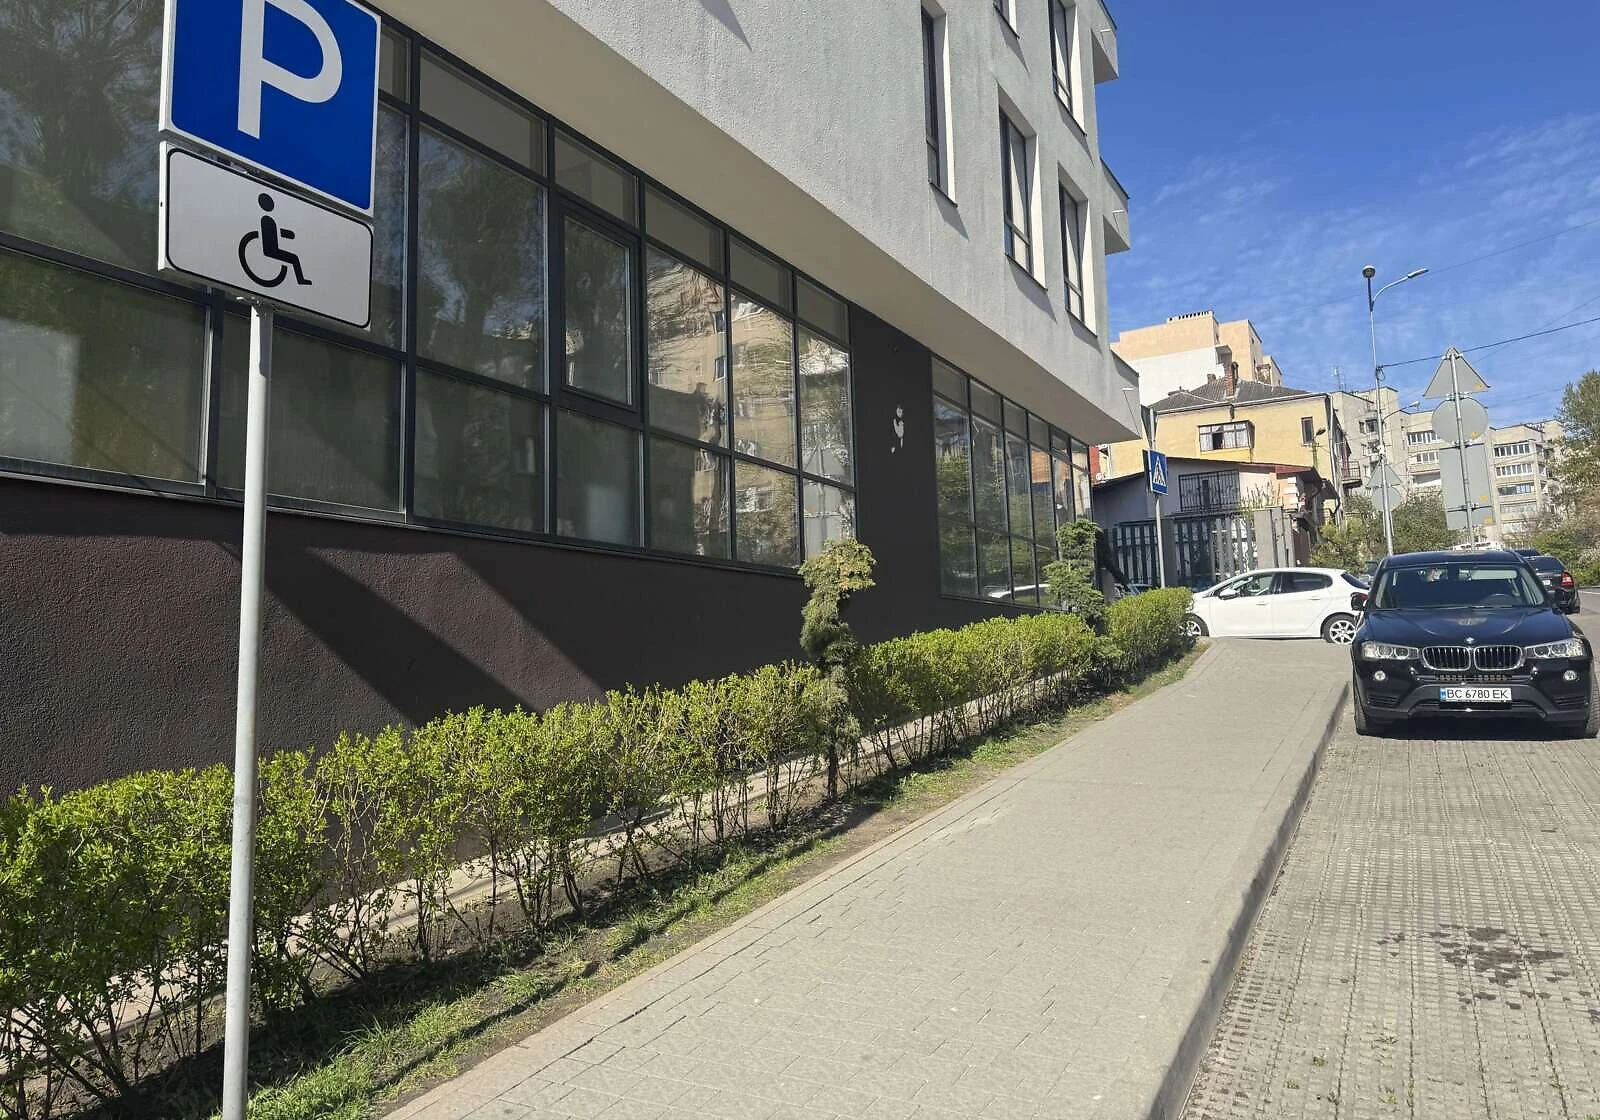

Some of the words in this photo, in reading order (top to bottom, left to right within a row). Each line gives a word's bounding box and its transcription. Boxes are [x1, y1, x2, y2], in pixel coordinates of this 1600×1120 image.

[238, 0, 342, 139] P
[1447, 689, 1462, 699] BC
[1465, 689, 1490, 699] 6780
[1492, 689, 1509, 699] EK
